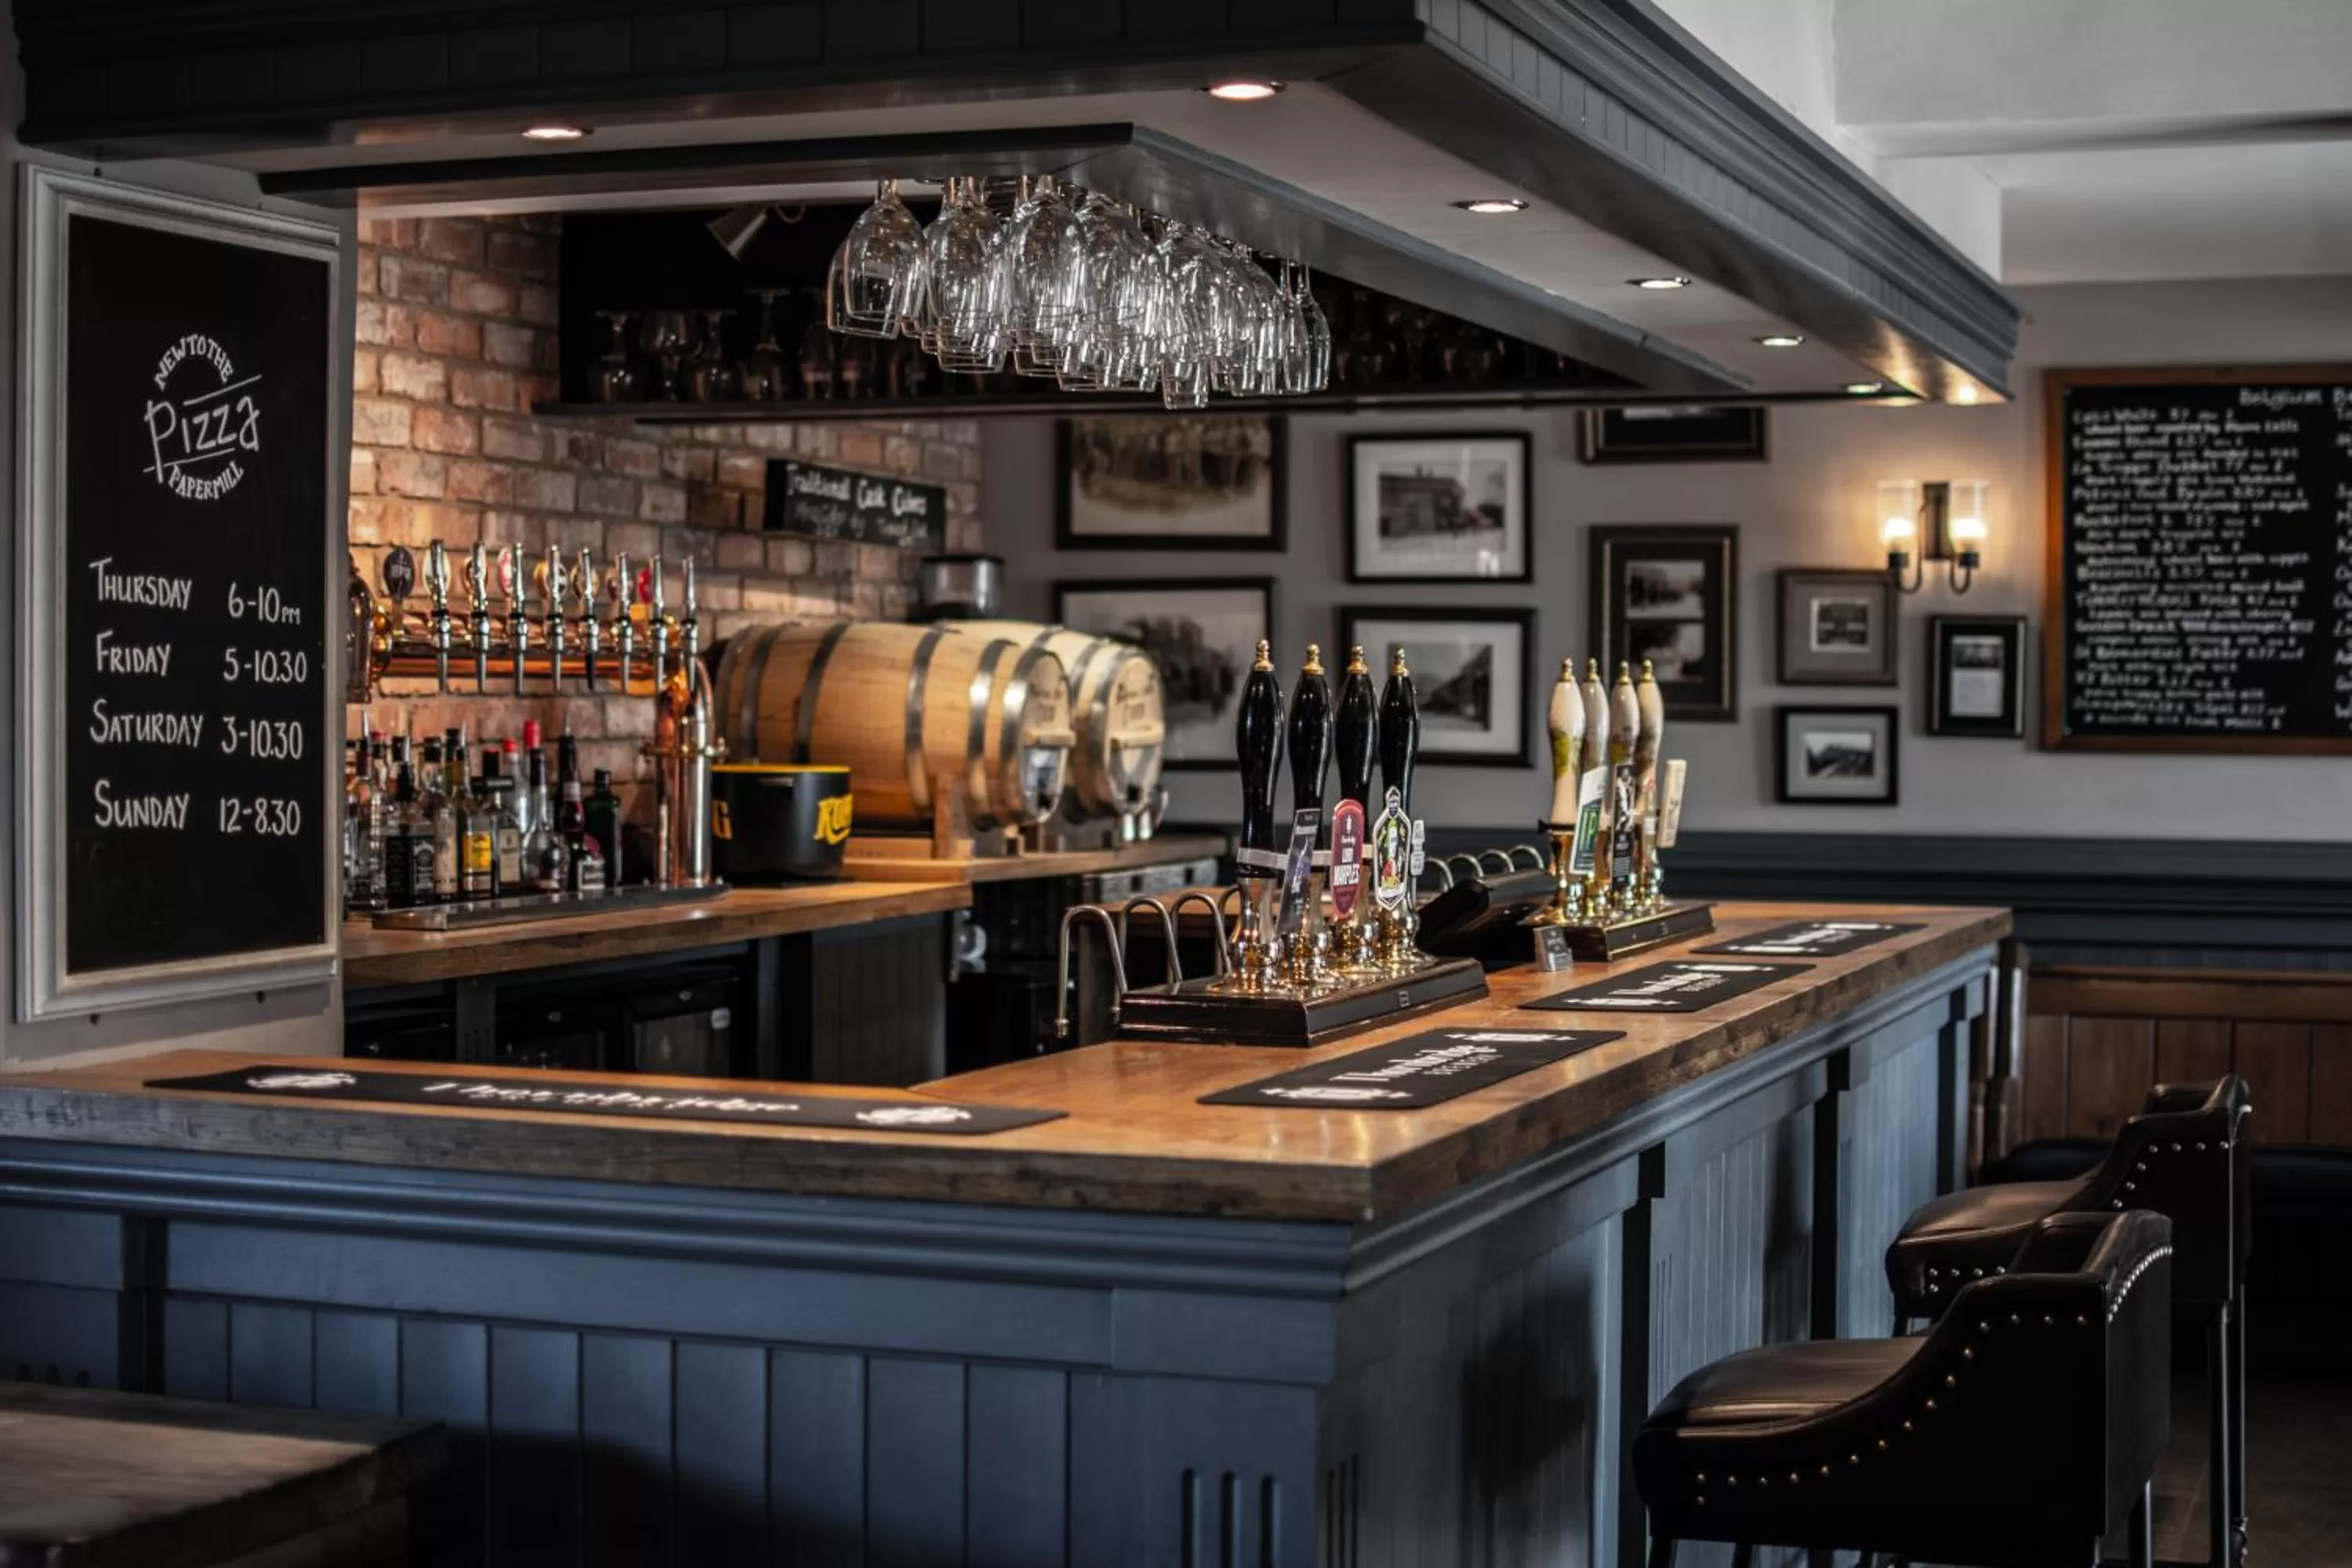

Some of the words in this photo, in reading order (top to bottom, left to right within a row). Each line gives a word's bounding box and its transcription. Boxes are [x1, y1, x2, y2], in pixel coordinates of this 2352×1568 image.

[154, 338, 188, 390] NEW
[188, 333, 207, 355] TO
[206, 338, 234, 384] THE
[168, 459, 244, 500] PAPERMILL
[89, 557, 193, 611] THURSDAY
[96, 630, 171, 676] FRIDAY
[89, 698, 204, 749] SATURDAY
[94, 779, 190, 830] SUNDAY
